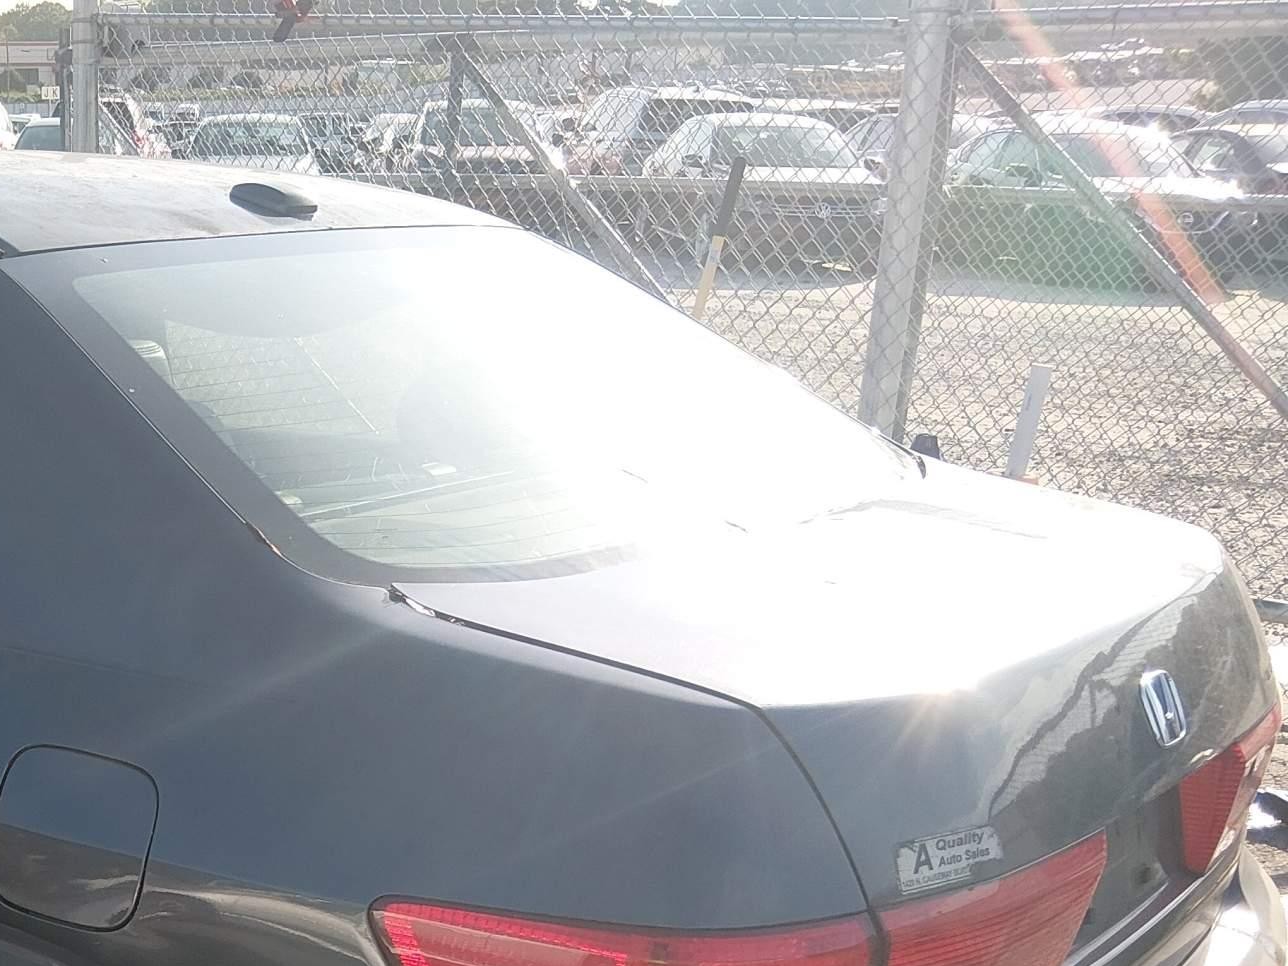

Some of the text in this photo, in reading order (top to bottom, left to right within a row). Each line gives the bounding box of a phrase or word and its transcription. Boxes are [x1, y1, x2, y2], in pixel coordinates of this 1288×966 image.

[935, 831, 985, 851] Quality
[912, 842, 934, 875] A
[938, 847, 991, 868] Auto Sales
